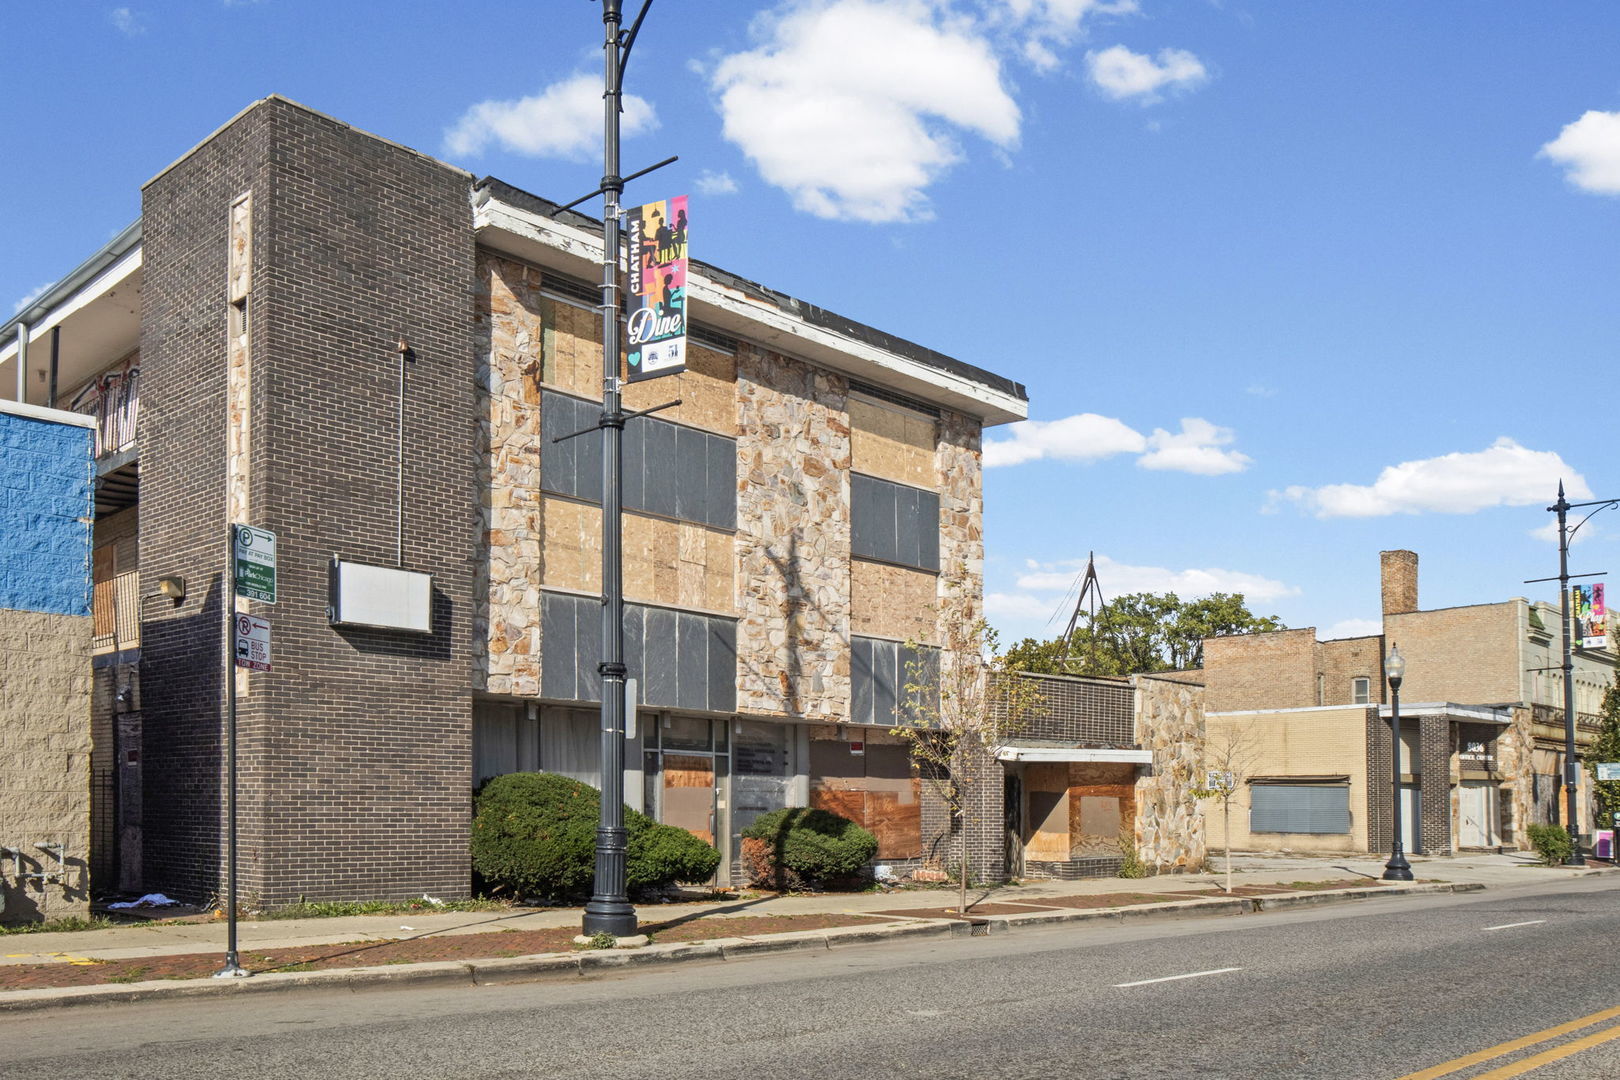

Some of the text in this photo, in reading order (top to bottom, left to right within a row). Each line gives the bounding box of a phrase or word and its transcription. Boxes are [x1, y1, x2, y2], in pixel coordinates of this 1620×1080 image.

[630, 219, 641, 294] CHATHAM
[627, 307, 682, 345] Dine
[246, 589, 258, 598] 391
[259, 592, 271, 601] 604
[250, 641, 264, 652] BUS
[250, 651, 267, 661] STOP
[238, 659, 269, 671] TOW ZONE
